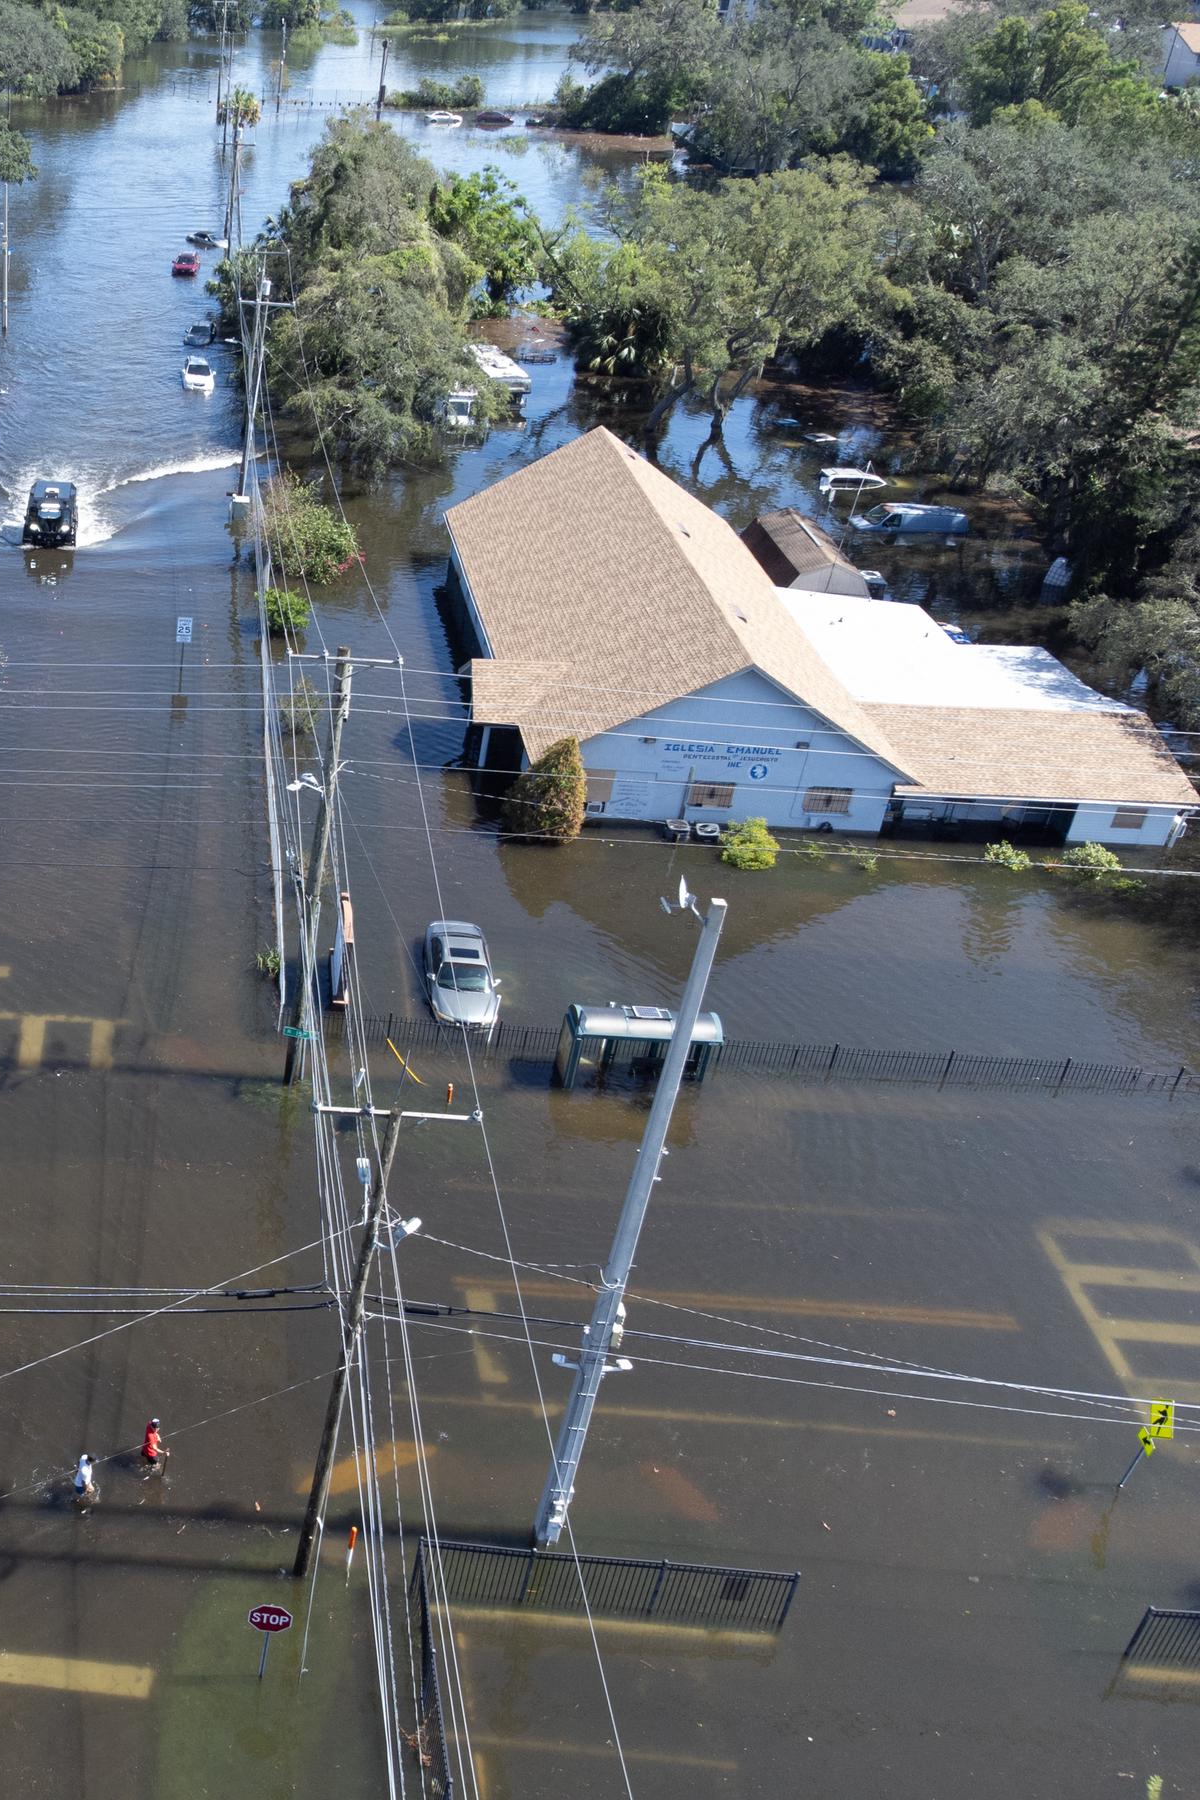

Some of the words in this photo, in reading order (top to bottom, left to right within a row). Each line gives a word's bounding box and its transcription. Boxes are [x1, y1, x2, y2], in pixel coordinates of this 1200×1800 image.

[664, 743, 715, 753] IGLESIA
[726, 746, 782, 756] EMANUEL
[683, 753, 731, 761] PENTECOSTAL
[251, 1612, 290, 1626] STOP
